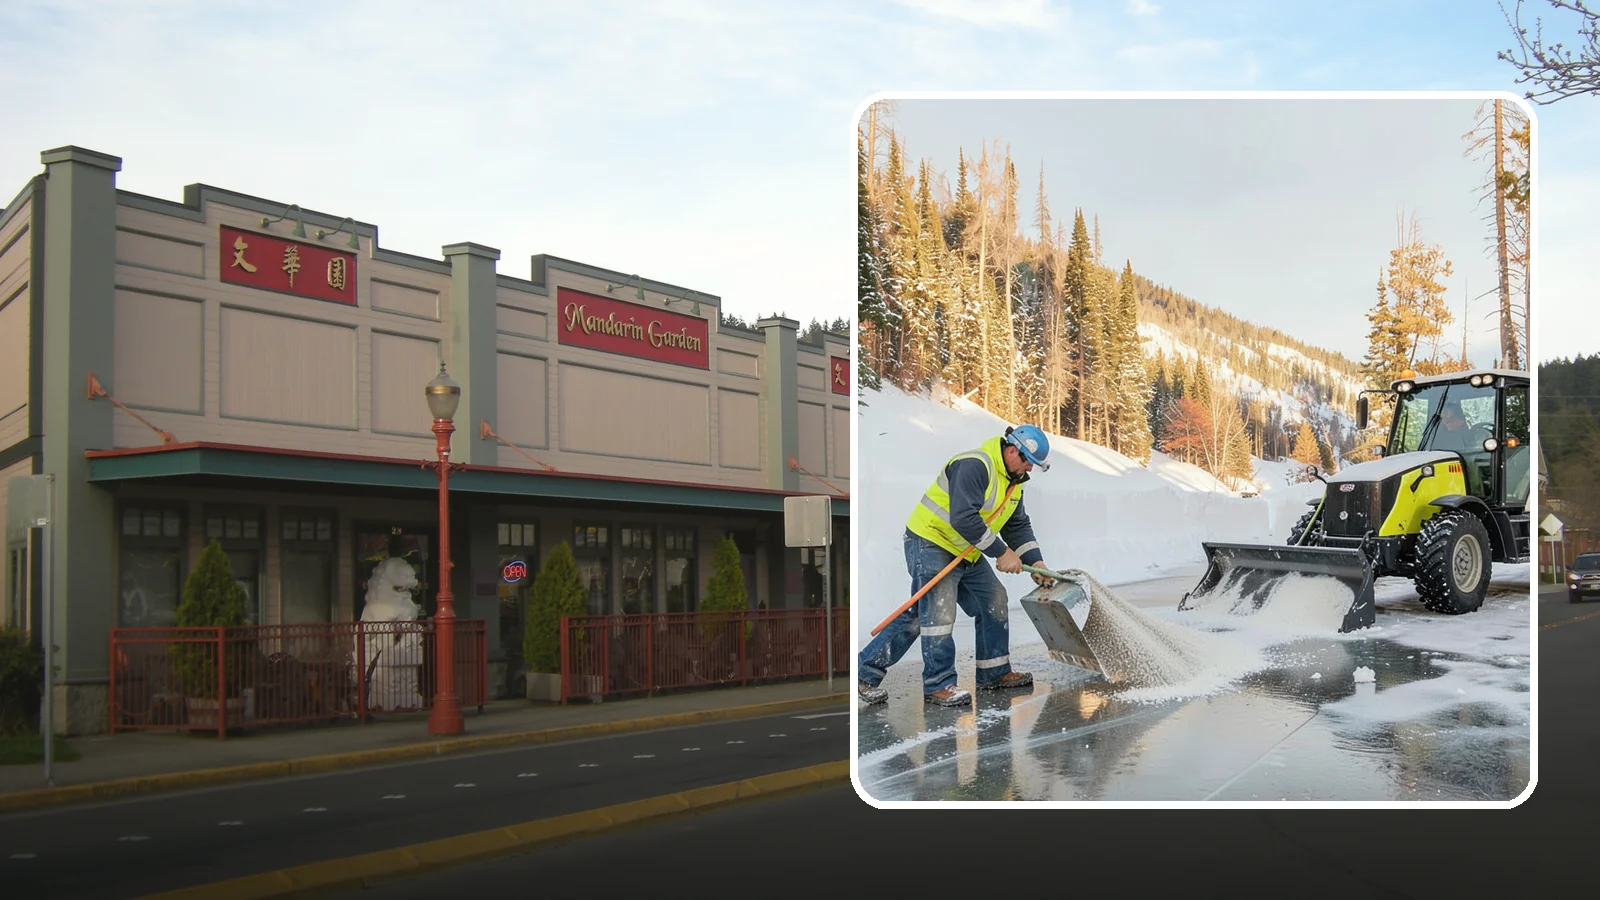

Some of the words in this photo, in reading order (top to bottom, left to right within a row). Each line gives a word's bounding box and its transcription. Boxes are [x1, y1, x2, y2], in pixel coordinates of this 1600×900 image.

[230, 235, 347, 291] 文華園
[564, 302, 644, 341] Mandarin
[647, 320, 702, 352] Garden
[503, 565, 527, 578] OPEN
